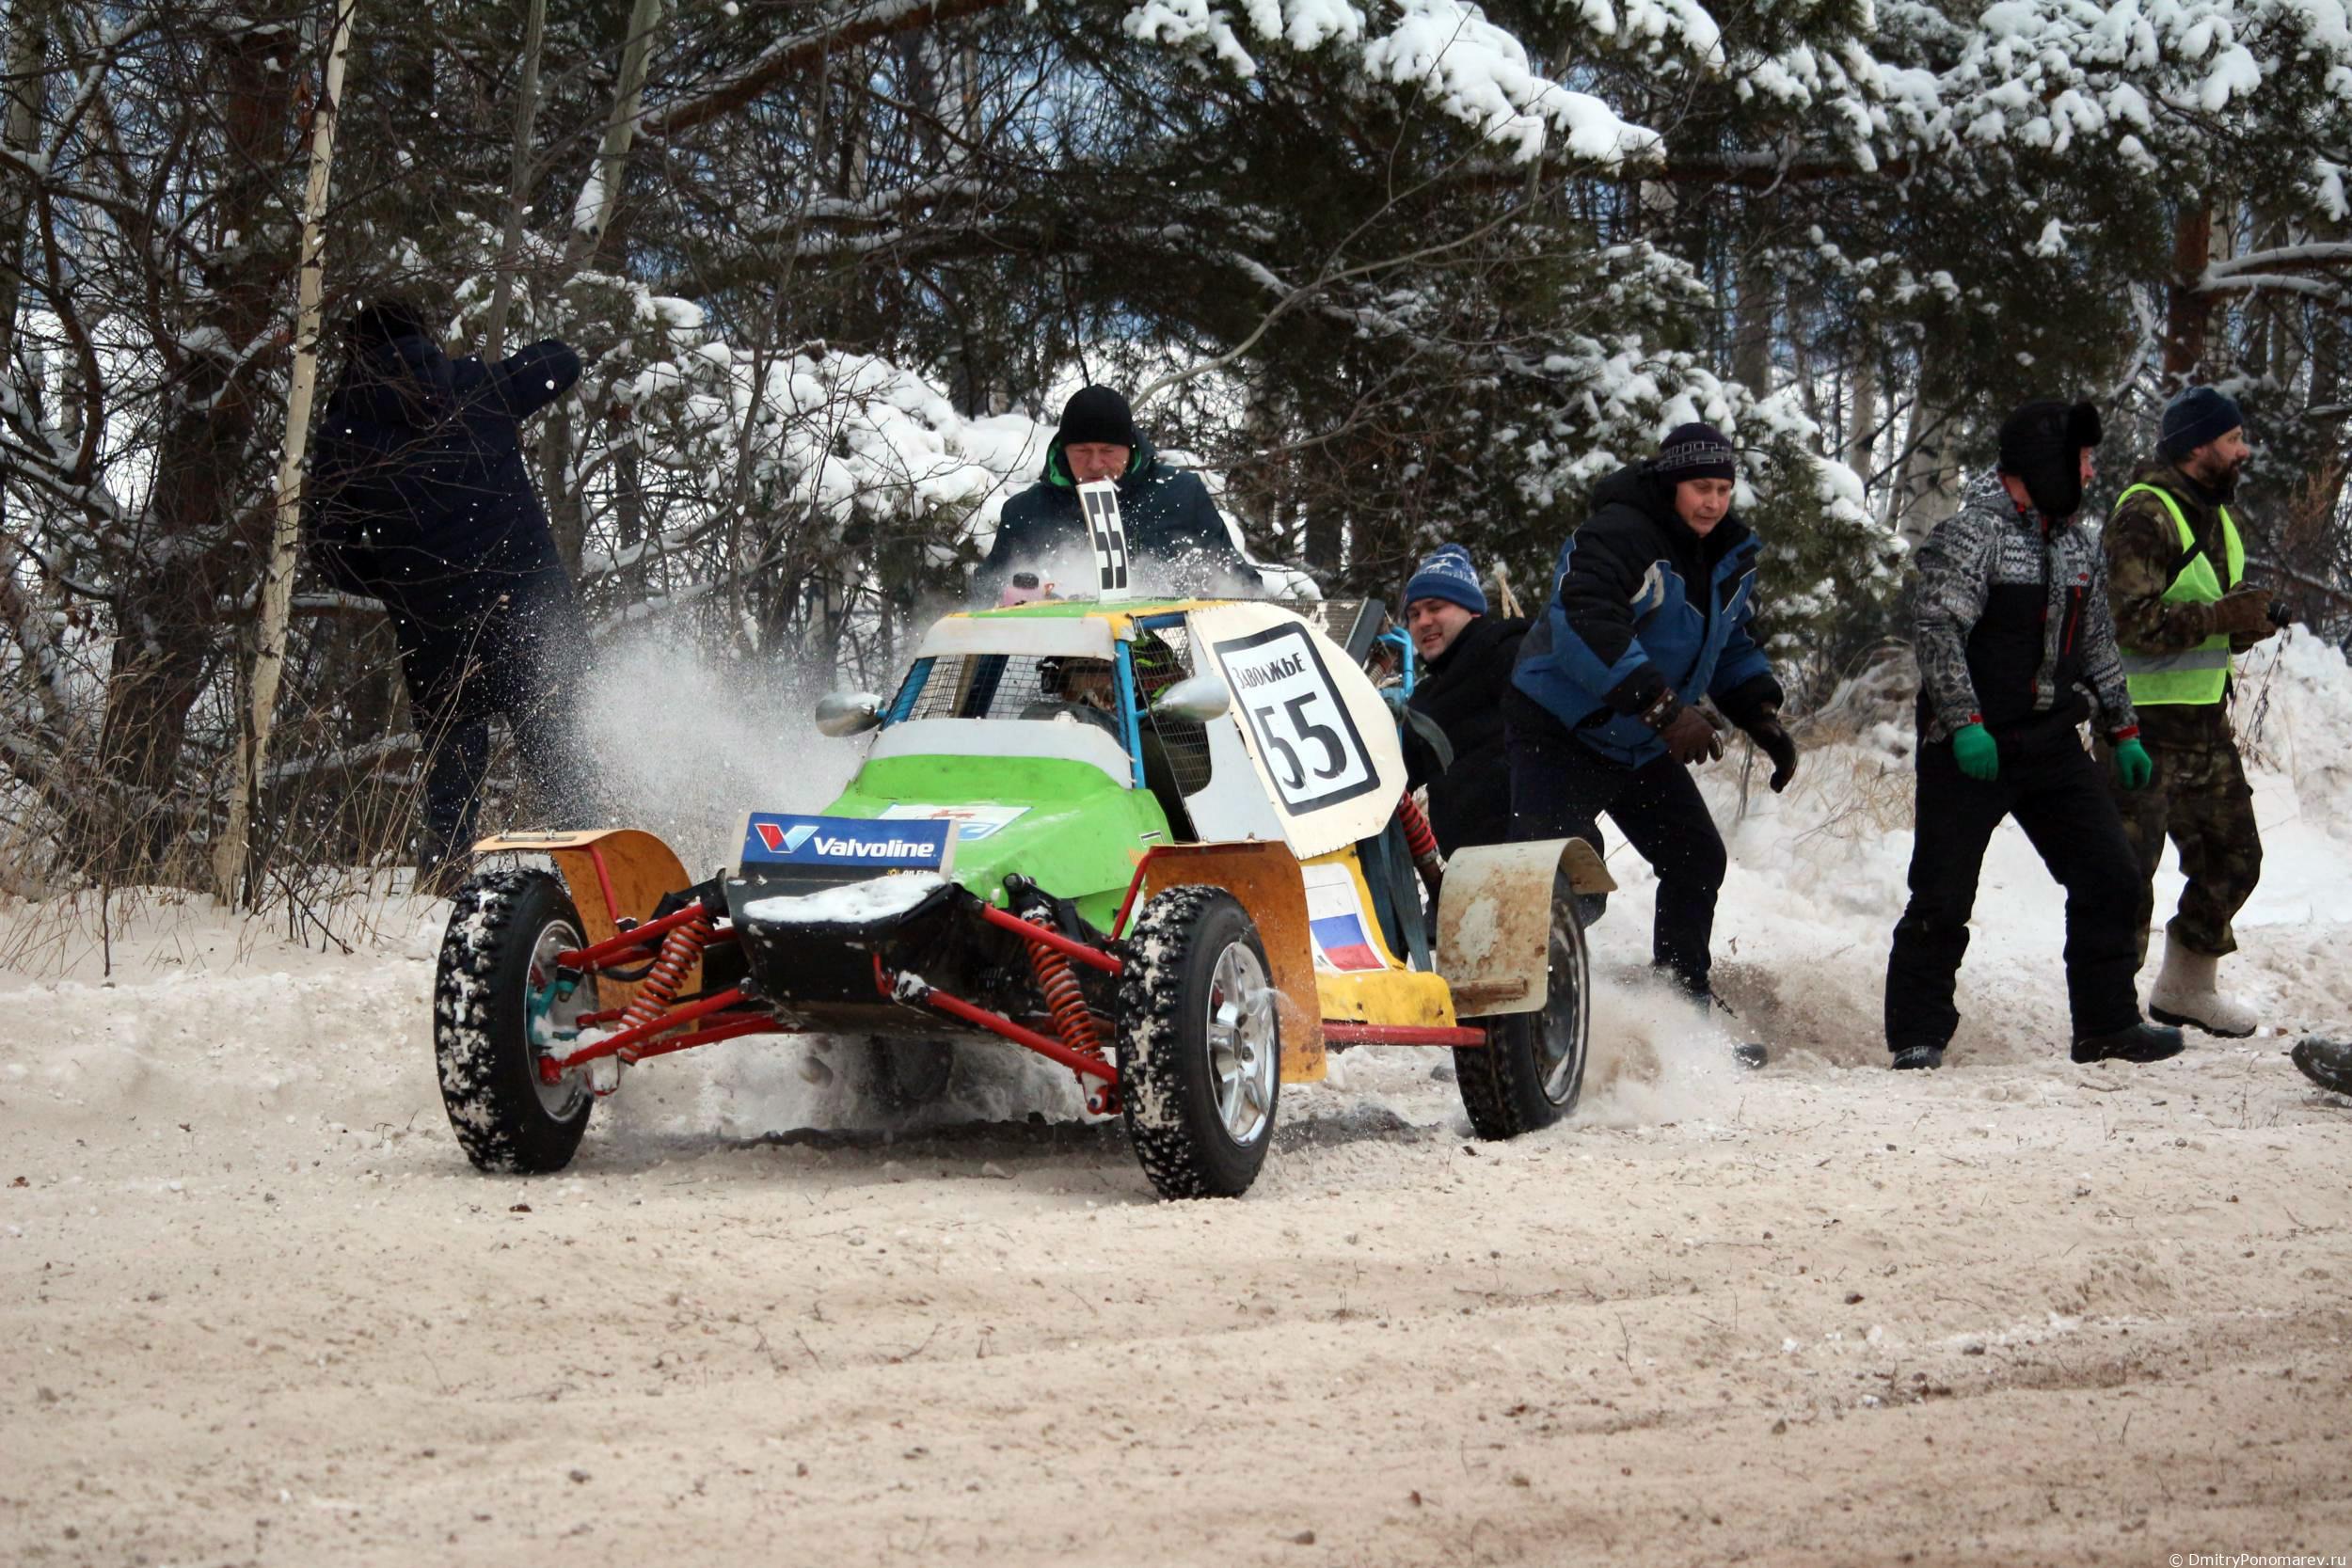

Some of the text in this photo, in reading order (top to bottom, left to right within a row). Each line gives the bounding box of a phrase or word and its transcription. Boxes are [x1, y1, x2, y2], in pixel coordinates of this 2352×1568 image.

[1084, 491, 1127, 590] 55
[1254, 691, 1347, 790] 55
[814, 836, 935, 858] Valvoline
